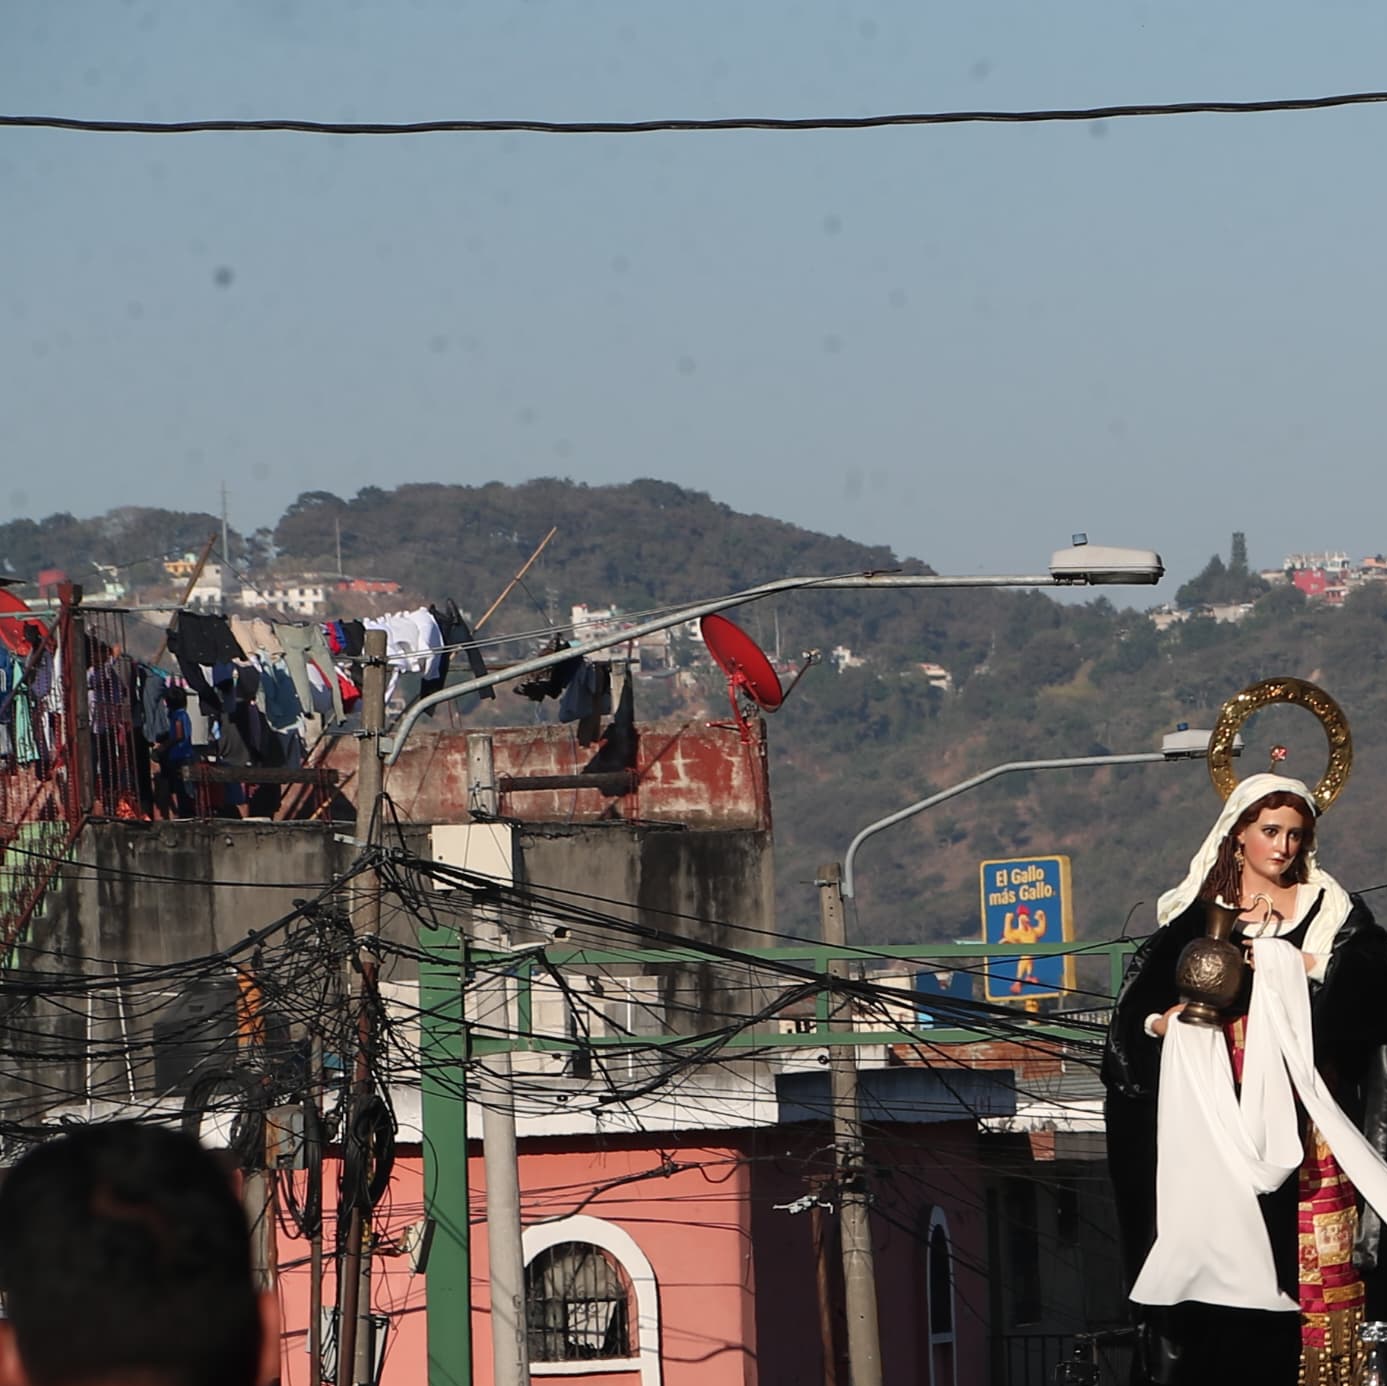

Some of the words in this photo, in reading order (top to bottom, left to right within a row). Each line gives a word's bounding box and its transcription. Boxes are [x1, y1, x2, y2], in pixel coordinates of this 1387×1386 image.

[996, 869, 1008, 887] El
[1011, 864, 1045, 885] Gallo
[989, 887, 1016, 906] más
